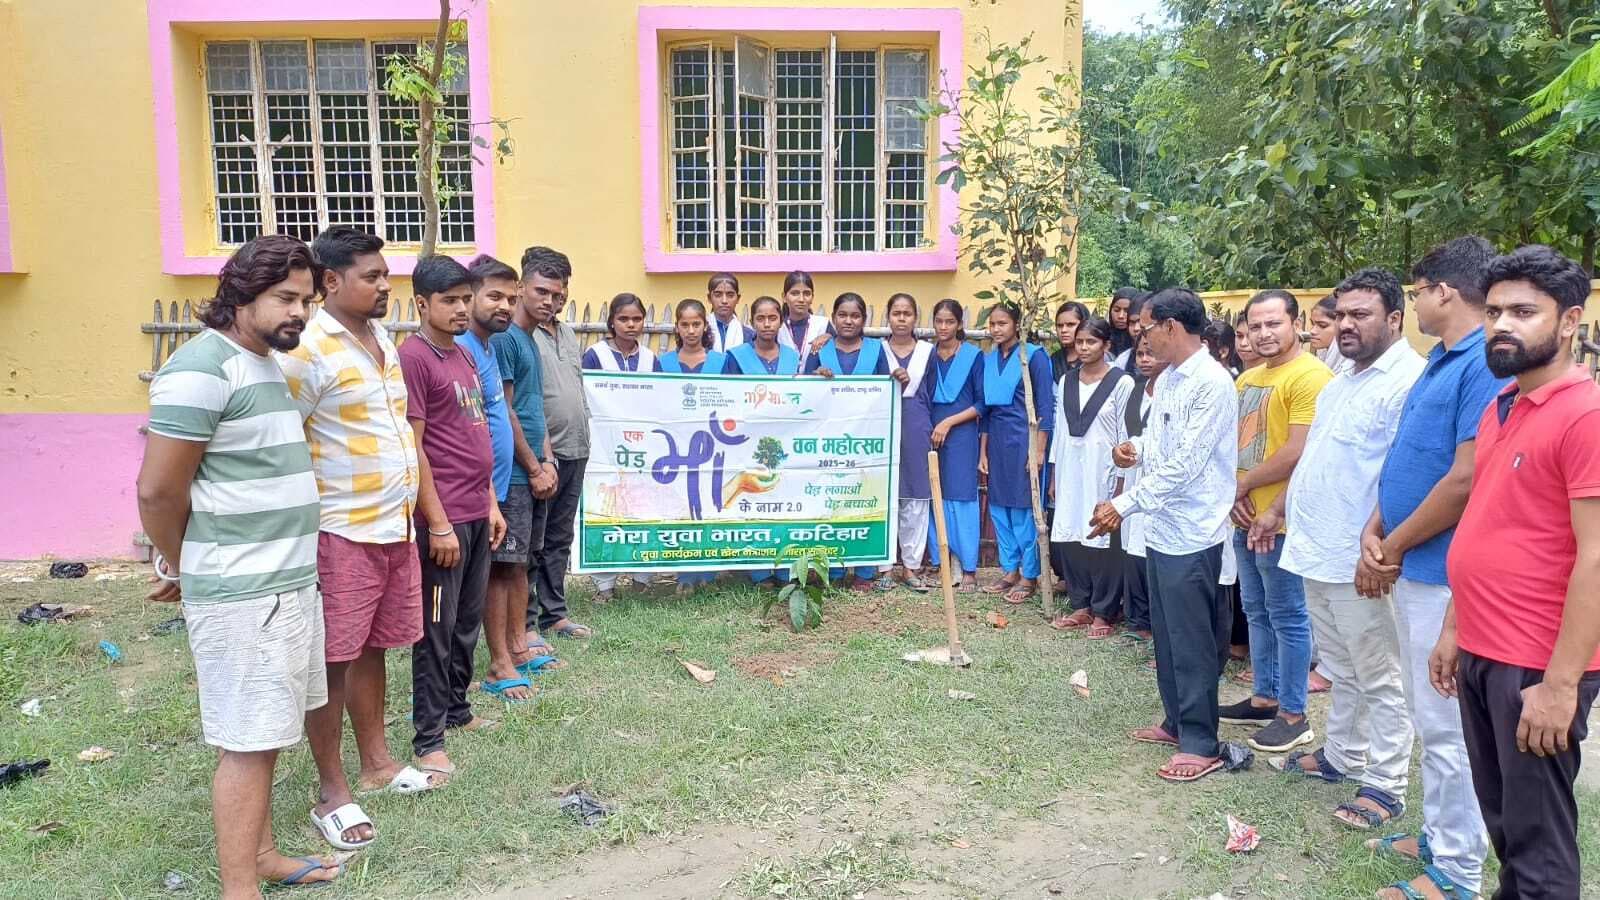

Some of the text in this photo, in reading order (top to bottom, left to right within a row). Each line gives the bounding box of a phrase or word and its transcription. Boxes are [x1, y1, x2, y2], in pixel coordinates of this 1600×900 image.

[623, 431, 645, 443] एक
[793, 433, 885, 455] वन महोत्सव
[614, 444, 647, 474] पेड़
[818, 459, 856, 468] 2025-26
[739, 499, 802, 513] के नाम 2.0
[603, 526, 650, 544] मेरा
[657, 529, 703, 547] युवा
[788, 524, 870, 541] कटिहार
